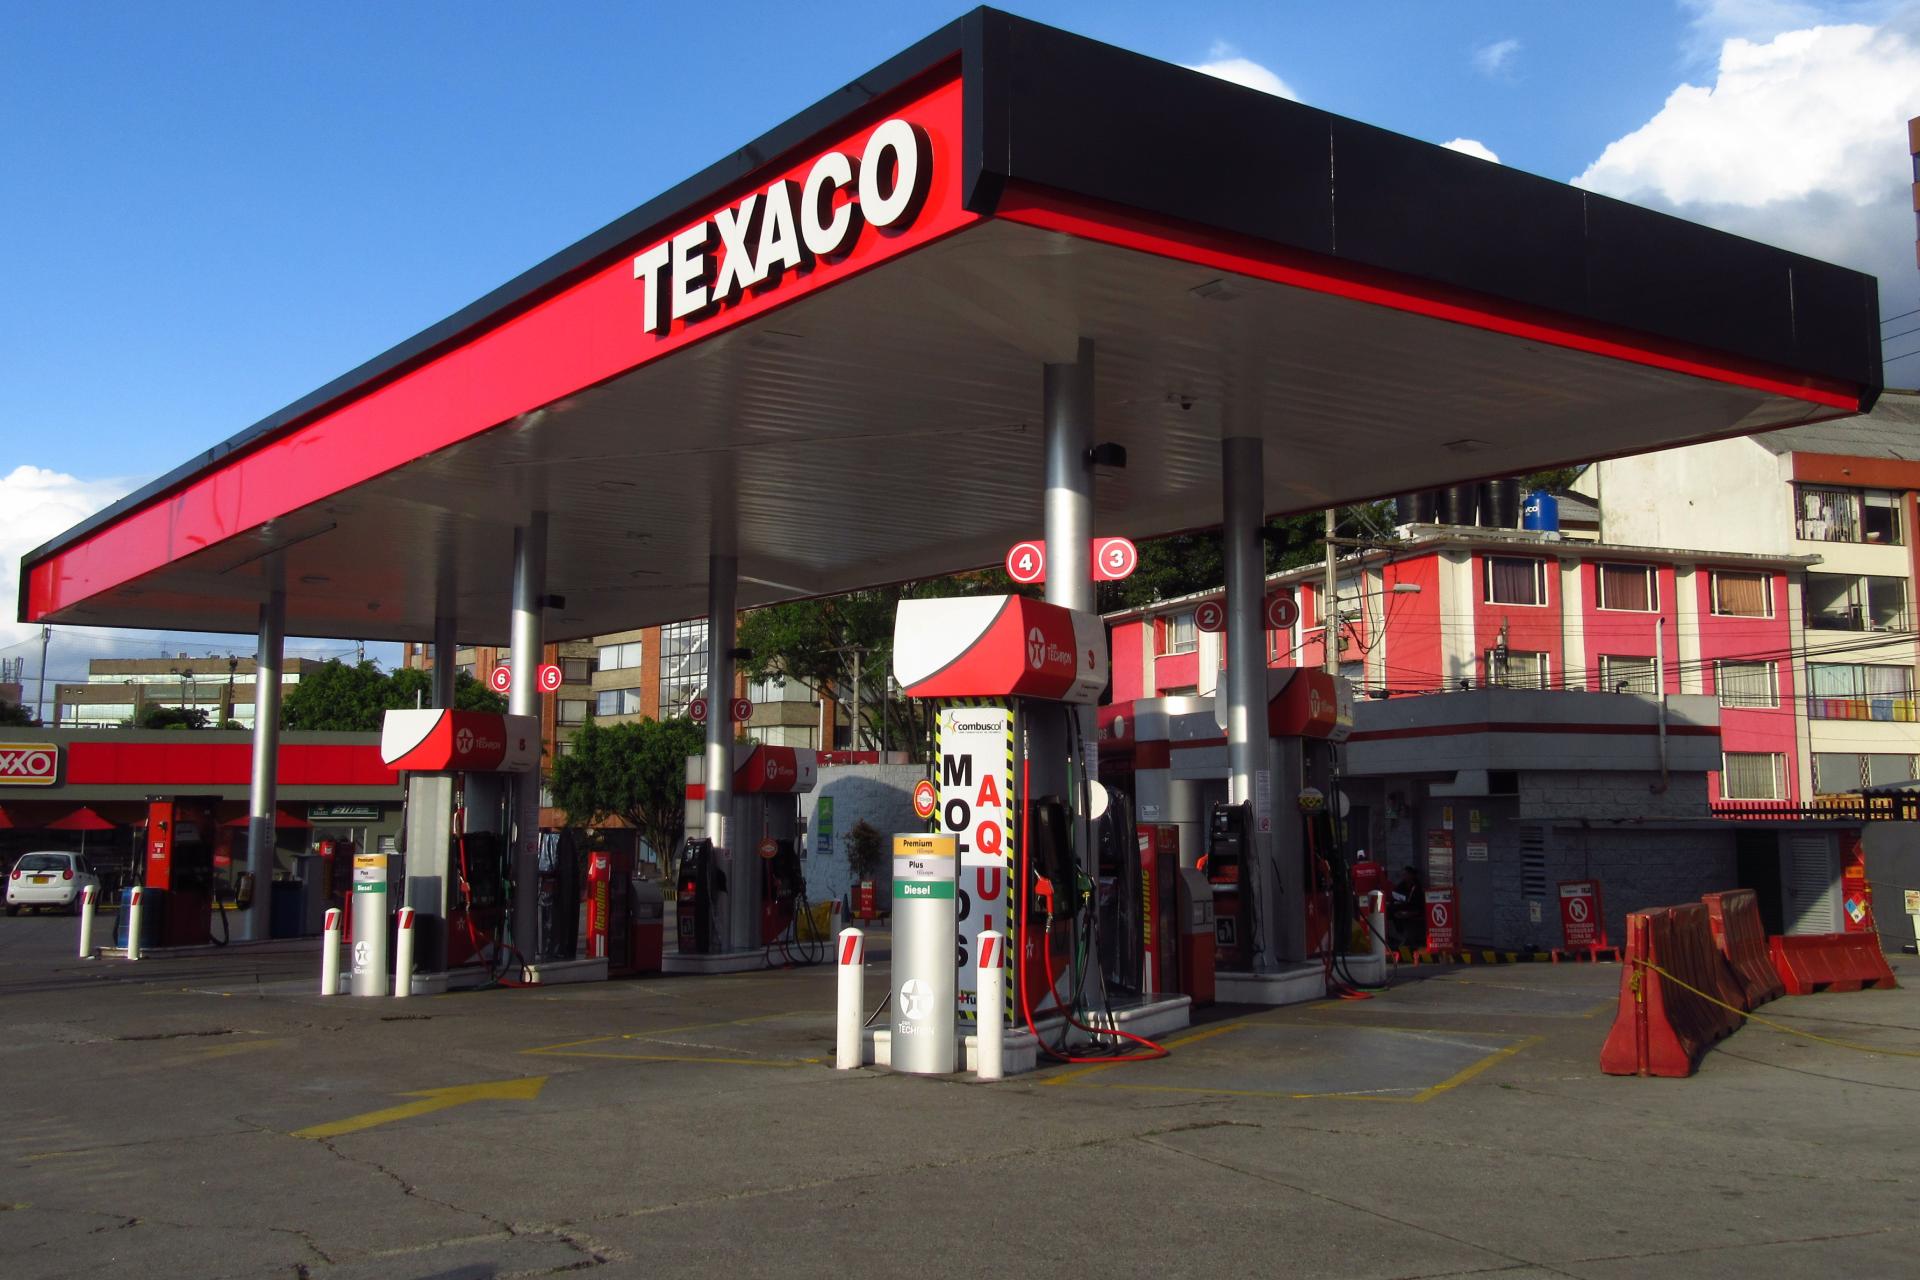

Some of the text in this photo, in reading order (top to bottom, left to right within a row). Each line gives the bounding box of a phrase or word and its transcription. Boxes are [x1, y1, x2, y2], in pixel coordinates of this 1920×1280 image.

[633, 118, 926, 336] TEXACO
[1019, 553, 1033, 571] 4
[1109, 549, 1124, 568] 3
[1203, 609, 1215, 624] 2
[1277, 606, 1286, 620] 1
[497, 673, 506, 685] 6
[547, 672, 556, 684] 5
[694, 704, 702, 715] 8
[740, 704, 747, 715] 7
[958, 721, 1002, 731] combuscol
[0, 750, 51, 775] XXO
[903, 839, 932, 848] Premium
[909, 860, 924, 869] Plus
[904, 884, 931, 895] Diesel
[594, 880, 606, 930] Havoline
